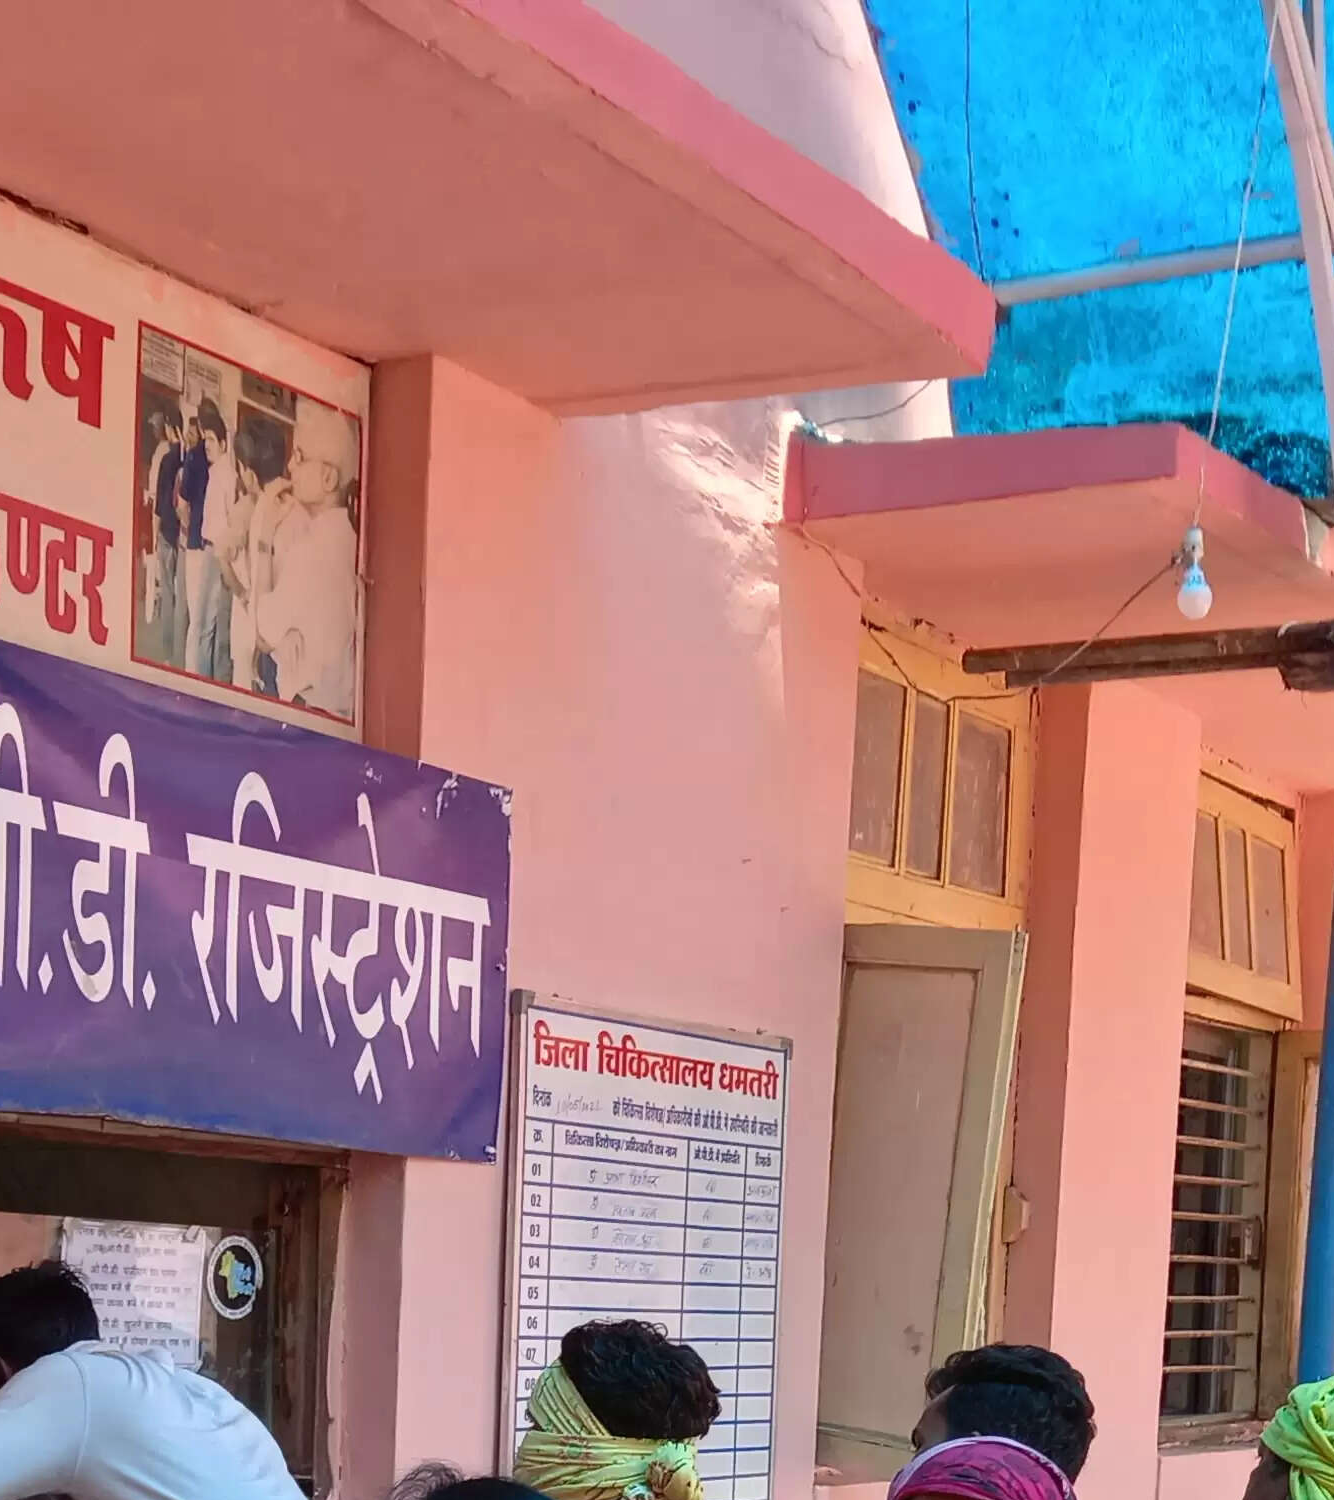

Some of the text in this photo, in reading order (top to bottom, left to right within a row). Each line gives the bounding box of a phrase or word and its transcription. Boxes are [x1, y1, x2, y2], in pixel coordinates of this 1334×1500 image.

[186, 771, 492, 1104] रजिस्ट्रेशन
[534, 1019, 780, 1100] जिला चिकित्सालय धमतरी
[531, 1162, 542, 1177] 01
[530, 1194, 542, 1208] 02
[529, 1224, 541, 1238] 03
[528, 1256, 540, 1270] 04
[527, 1286, 539, 1300] 05
[526, 1316, 538, 1330] 06
[526, 1347, 536, 1360] 07
[524, 1377, 536, 1391] 08
